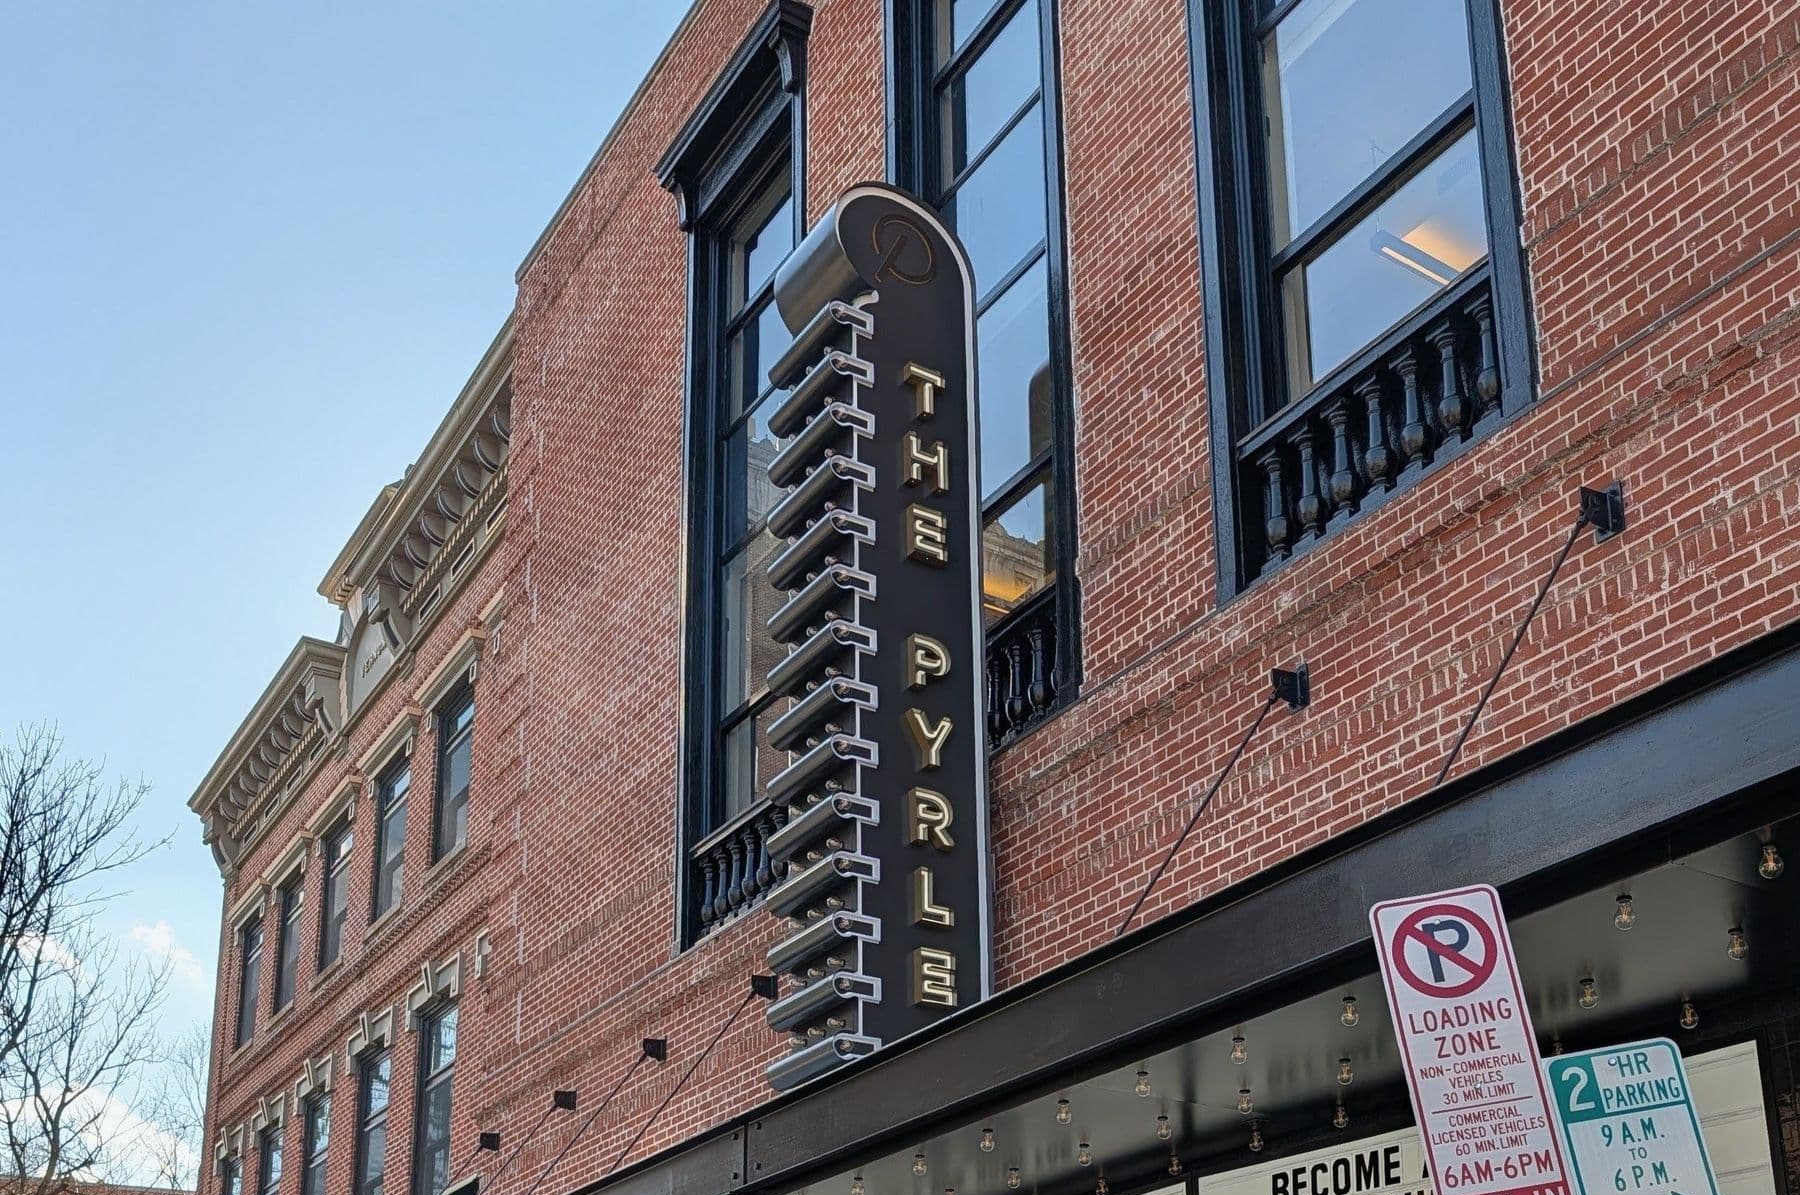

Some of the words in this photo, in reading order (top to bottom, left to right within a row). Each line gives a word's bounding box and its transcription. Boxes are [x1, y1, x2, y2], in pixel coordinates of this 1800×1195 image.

[904, 360, 949, 566] THE
[905, 632, 957, 1007] PYRLE
[1409, 998, 1512, 1034] LOADING
[1434, 1028, 1500, 1059] ZONE
[1420, 1052, 1526, 1080] NON-COMMERCIAL
[1449, 1070, 1504, 1089] VEHICLES
[1561, 1066, 1596, 1112] 2
[1616, 1052, 1651, 1078] HR
[1603, 1076, 1680, 1110] PARKING
[1443, 1092, 1458, 1105] 30
[1431, 1126, 1487, 1145] LICENSED
[1490, 1116, 1546, 1135] VEHICLES
[1448, 1105, 1522, 1128] COMMERCIAL
[1601, 1124, 1613, 1147] 9
[1621, 1117, 1665, 1145] A.M.
[1456, 1143, 1470, 1156] 60
[1628, 1147, 1648, 1161] TO
[1444, 1149, 1554, 1188] 6AM-6PM
[1614, 1168, 1627, 1192] 6
[1632, 1161, 1677, 1189] P.M.
